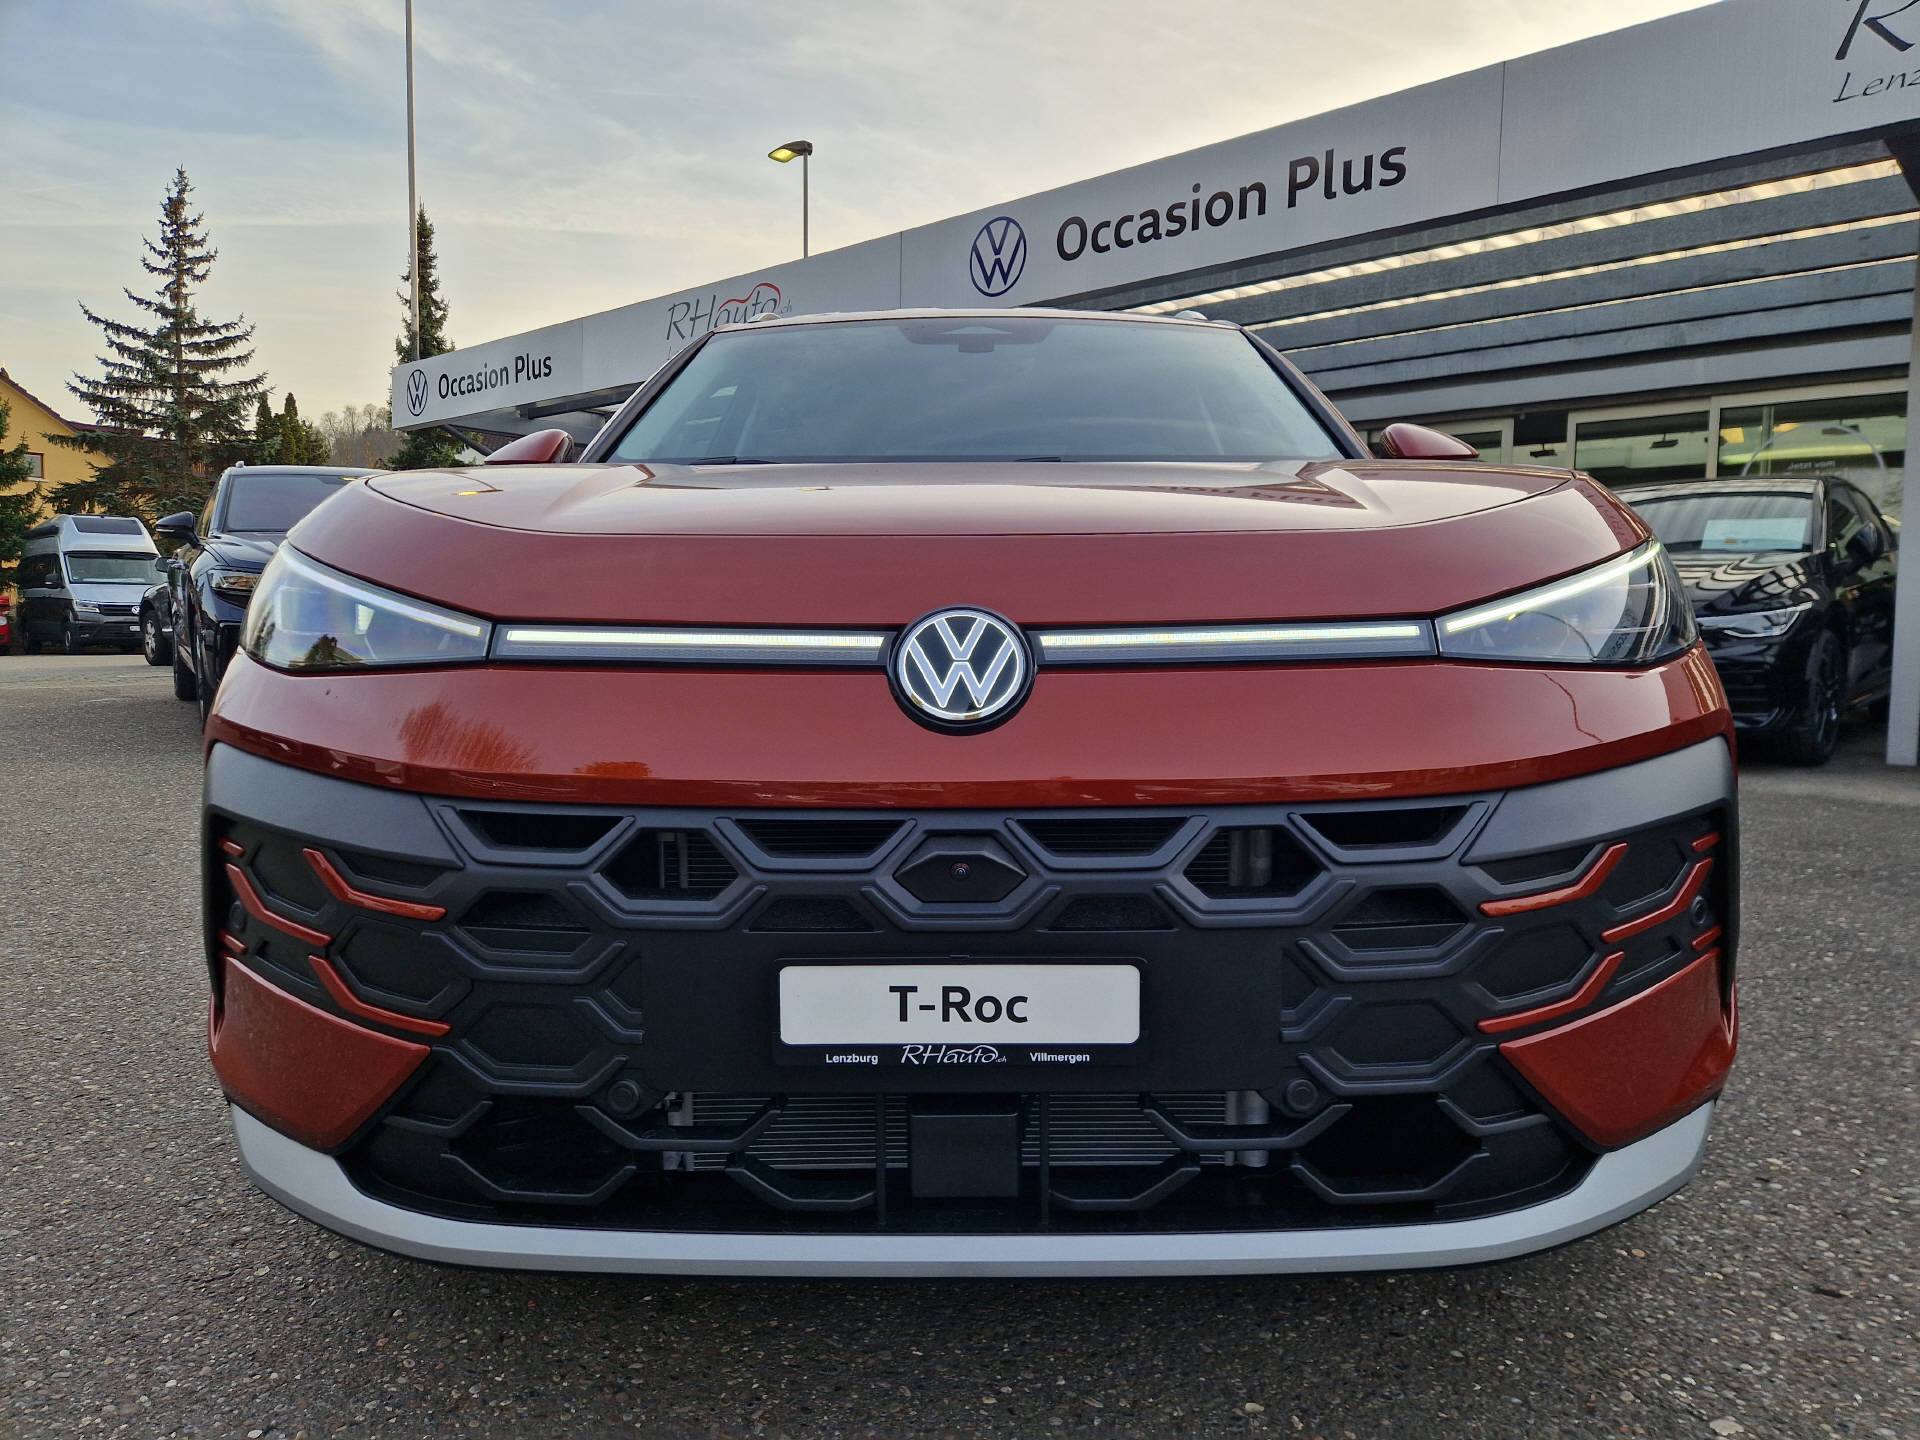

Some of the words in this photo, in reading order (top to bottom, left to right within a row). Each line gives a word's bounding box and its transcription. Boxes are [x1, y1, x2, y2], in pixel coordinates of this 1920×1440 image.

[1056, 183, 1266, 262] Occasion
[1287, 146, 1407, 208] Plus
[970, 216, 1027, 297] VW
[438, 362, 509, 399] Occasion
[515, 353, 552, 383] Plus
[900, 611, 1022, 719] VW
[889, 985, 1029, 1023] T-Roc
[825, 1053, 879, 1065] Lenzburg
[1029, 1052, 1090, 1063] Villmergen
